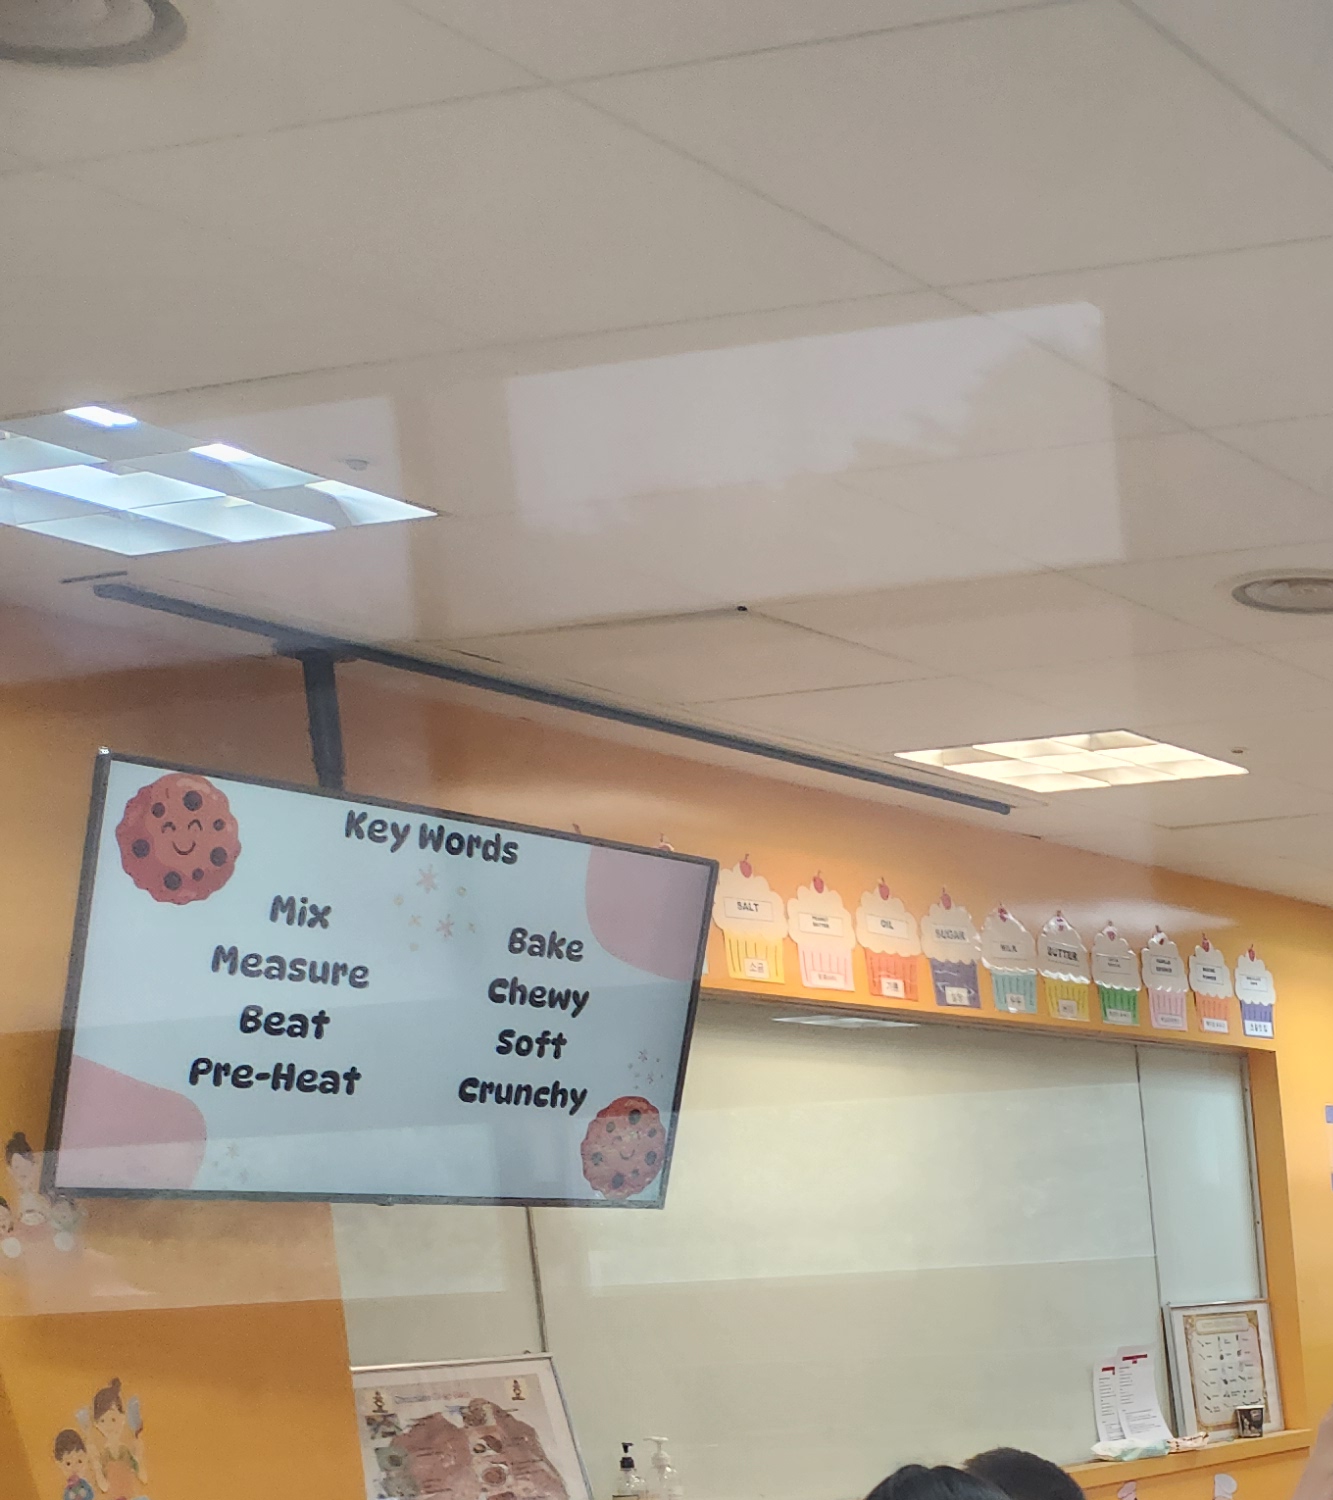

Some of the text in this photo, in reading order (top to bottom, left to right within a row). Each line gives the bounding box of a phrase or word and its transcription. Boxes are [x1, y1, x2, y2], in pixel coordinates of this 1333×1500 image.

[345, 809, 519, 864] Key Words
[269, 895, 331, 928] Mix
[737, 901, 759, 912] SALT
[880, 919, 894, 930] OIL
[935, 929, 966, 941] SUGAR
[508, 926, 584, 962] Bake
[211, 944, 369, 989] Measure
[488, 977, 589, 1018] Chewy
[239, 1005, 330, 1039] Beat
[495, 1029, 567, 1060] Soft
[189, 1057, 361, 1095] Pre-Heat
[458, 1076, 588, 1115] Crunchy
